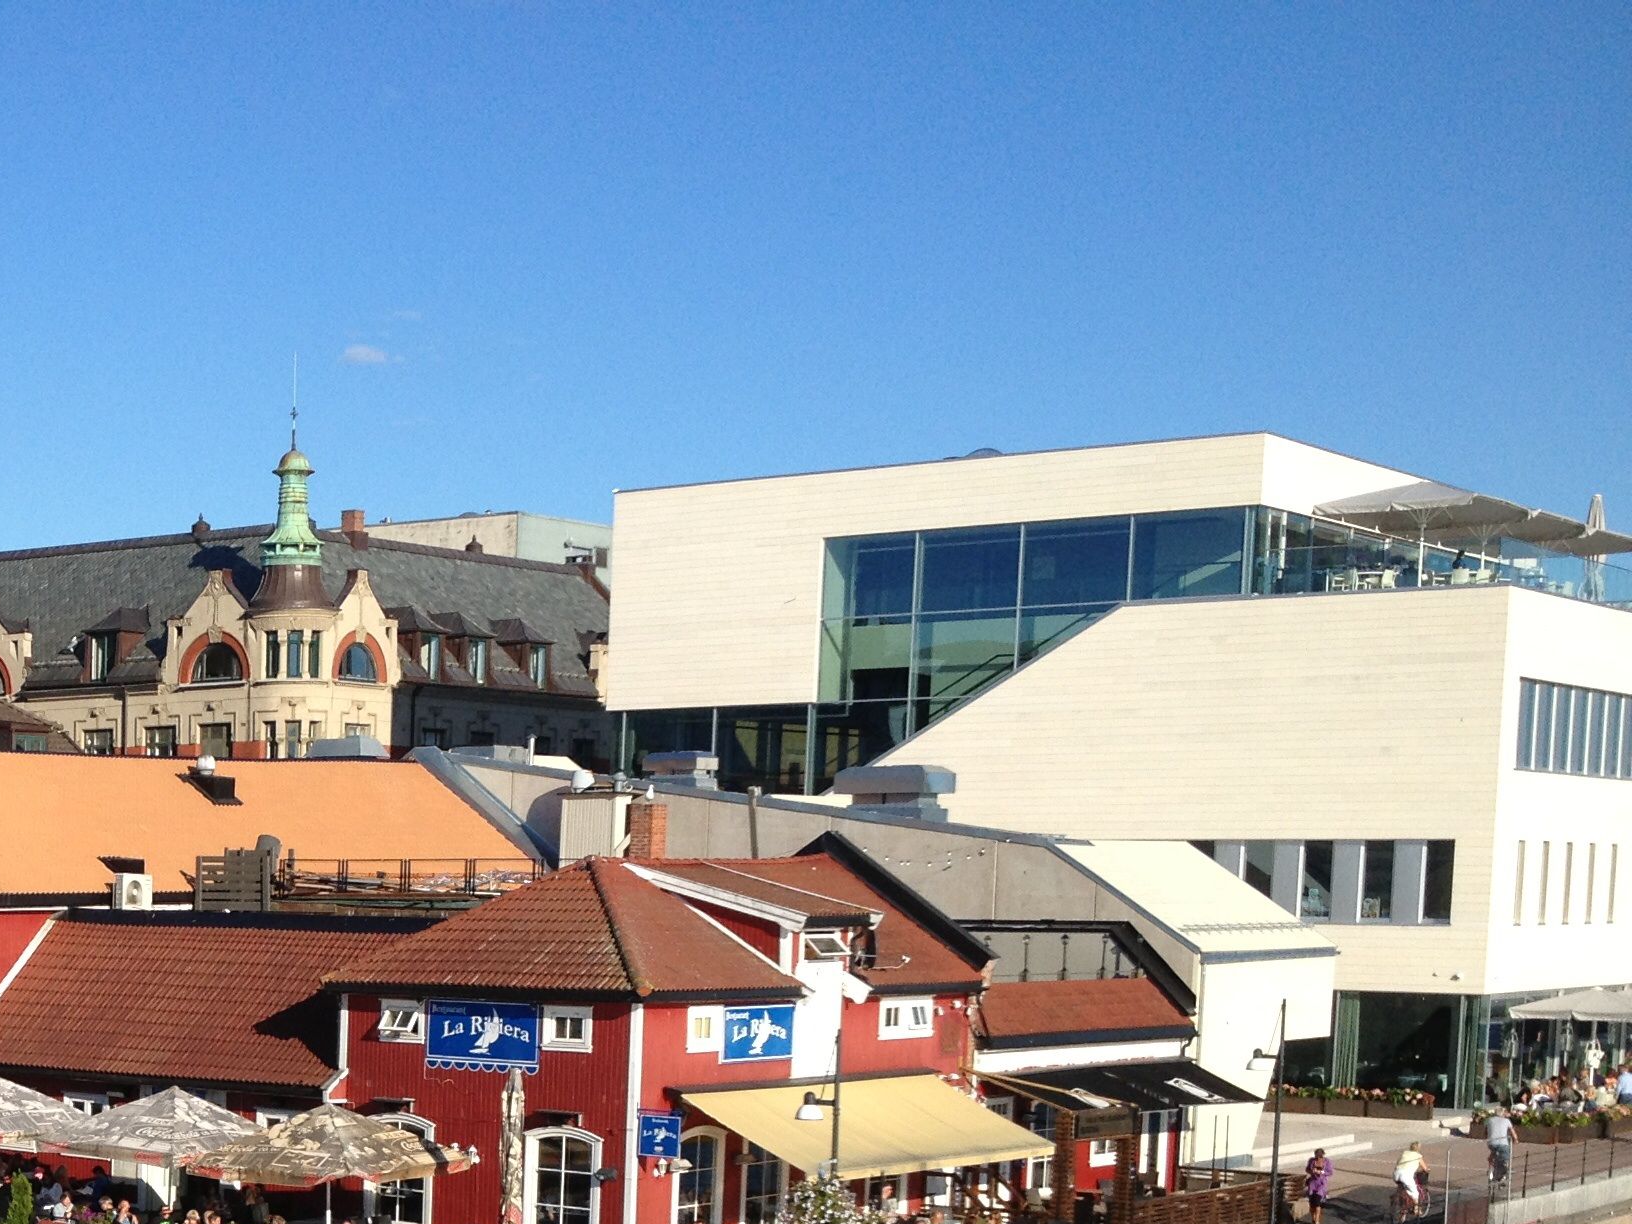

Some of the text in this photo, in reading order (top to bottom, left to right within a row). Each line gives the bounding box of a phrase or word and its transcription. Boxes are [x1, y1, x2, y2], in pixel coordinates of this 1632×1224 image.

[441, 1015, 530, 1044] La Riiera
[731, 1018, 787, 1043] La Riiera
